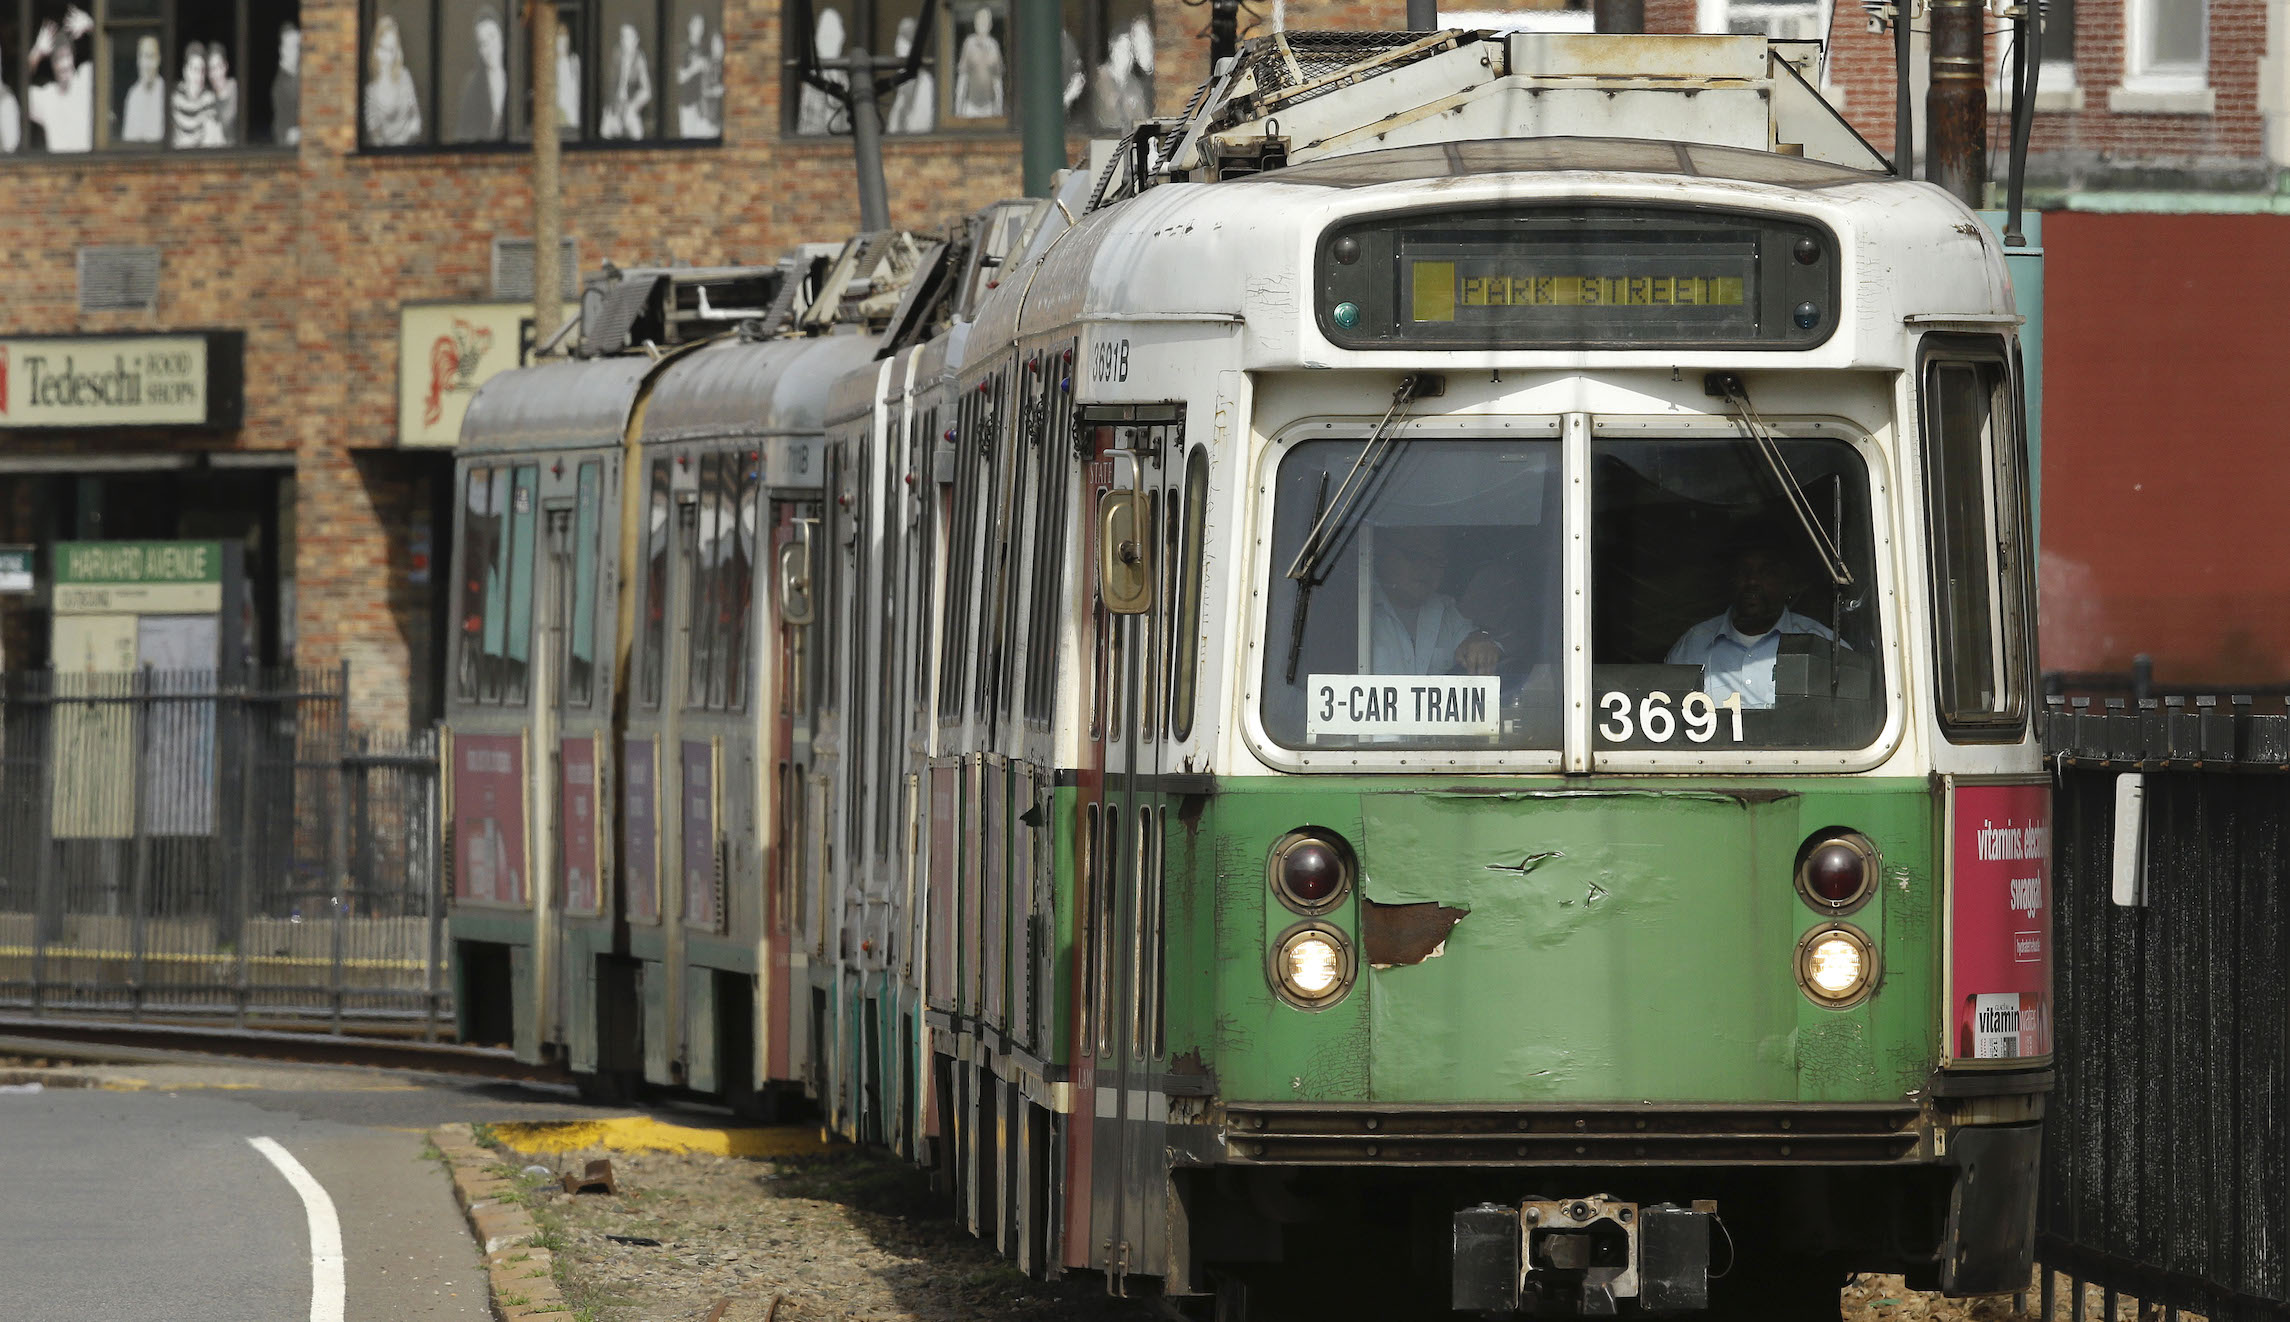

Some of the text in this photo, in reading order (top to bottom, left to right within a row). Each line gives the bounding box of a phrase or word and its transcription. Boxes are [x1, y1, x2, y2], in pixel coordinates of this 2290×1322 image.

[1464, 276, 1717, 304] PARK STREET
[147, 351, 193, 376] FOOD
[1092, 339, 1130, 382] 3691B
[23, 355, 141, 405] Tedeschi
[1089, 462, 1113, 484] STATE
[69, 547, 207, 579] HARVARD AVENUE
[1319, 686, 1486, 722] 3-CAR TRAIN
[1599, 690, 1744, 743] 3691
[1977, 819, 2023, 861] vitamins.
[1078, 1068, 1094, 1089] LAW
